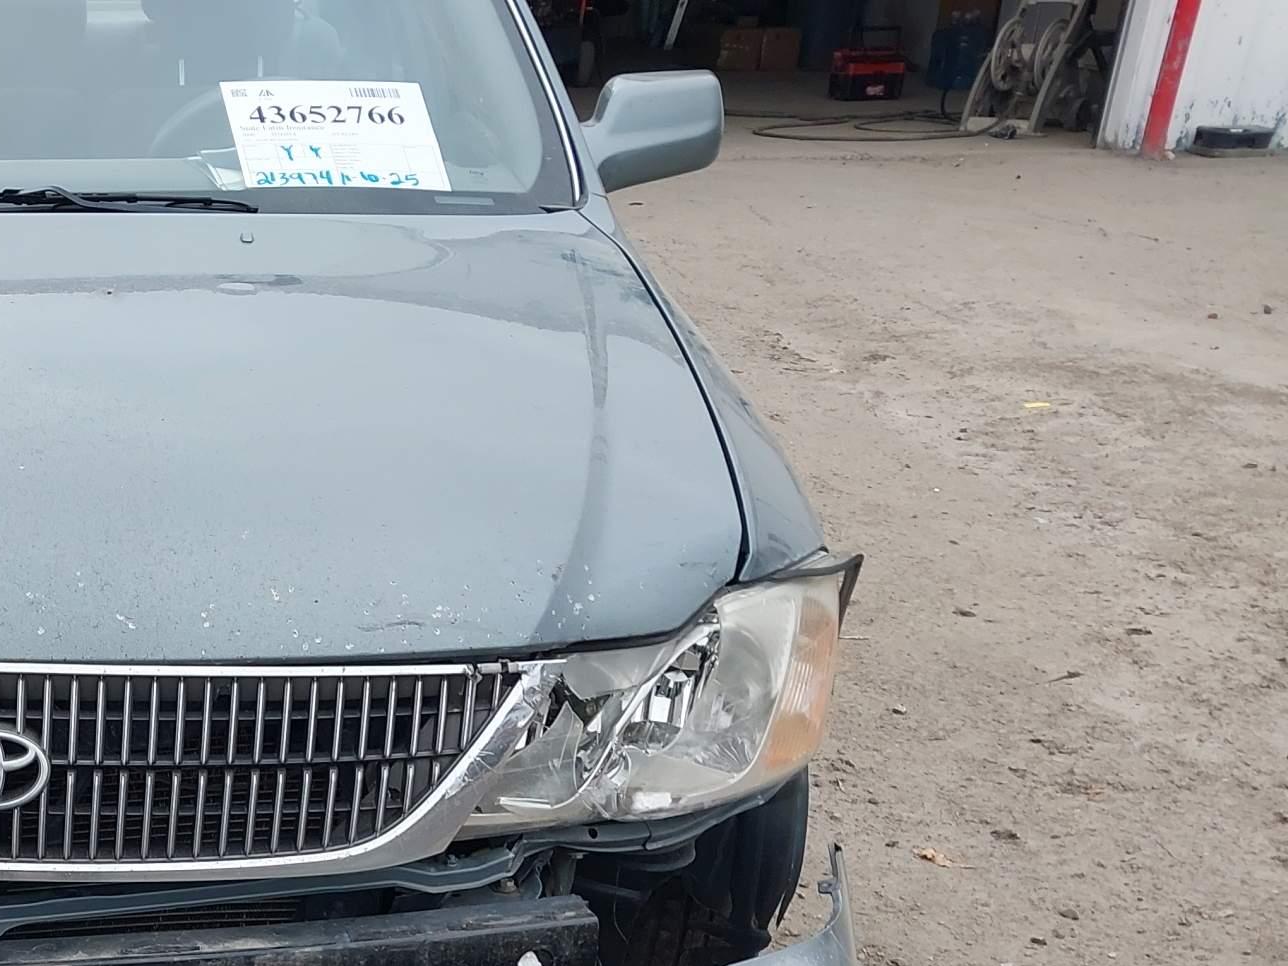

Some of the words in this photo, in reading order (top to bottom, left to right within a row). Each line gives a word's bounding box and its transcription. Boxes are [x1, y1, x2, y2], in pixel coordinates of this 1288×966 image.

[249, 105, 406, 125] 43652766
[280, 144, 294, 161] Y
[256, 170, 333, 186] 213974
